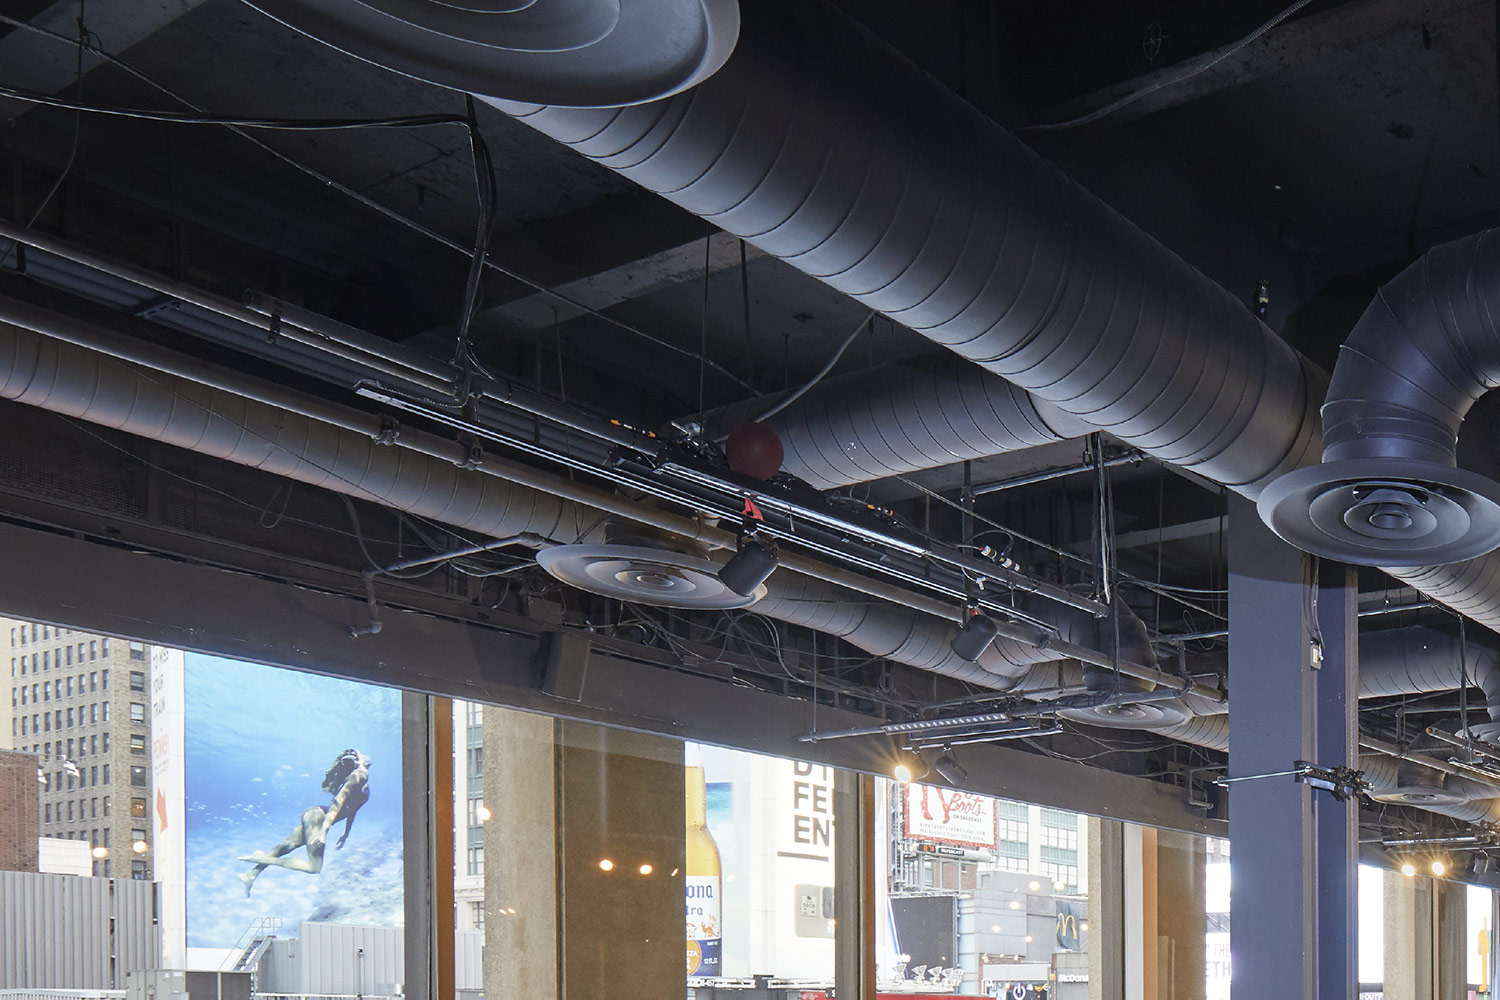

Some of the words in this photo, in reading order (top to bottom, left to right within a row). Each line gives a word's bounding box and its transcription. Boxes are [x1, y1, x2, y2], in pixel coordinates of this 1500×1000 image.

[794, 780, 835, 816] FE
[949, 792, 987, 817] Boots
[794, 814, 835, 847] EN
